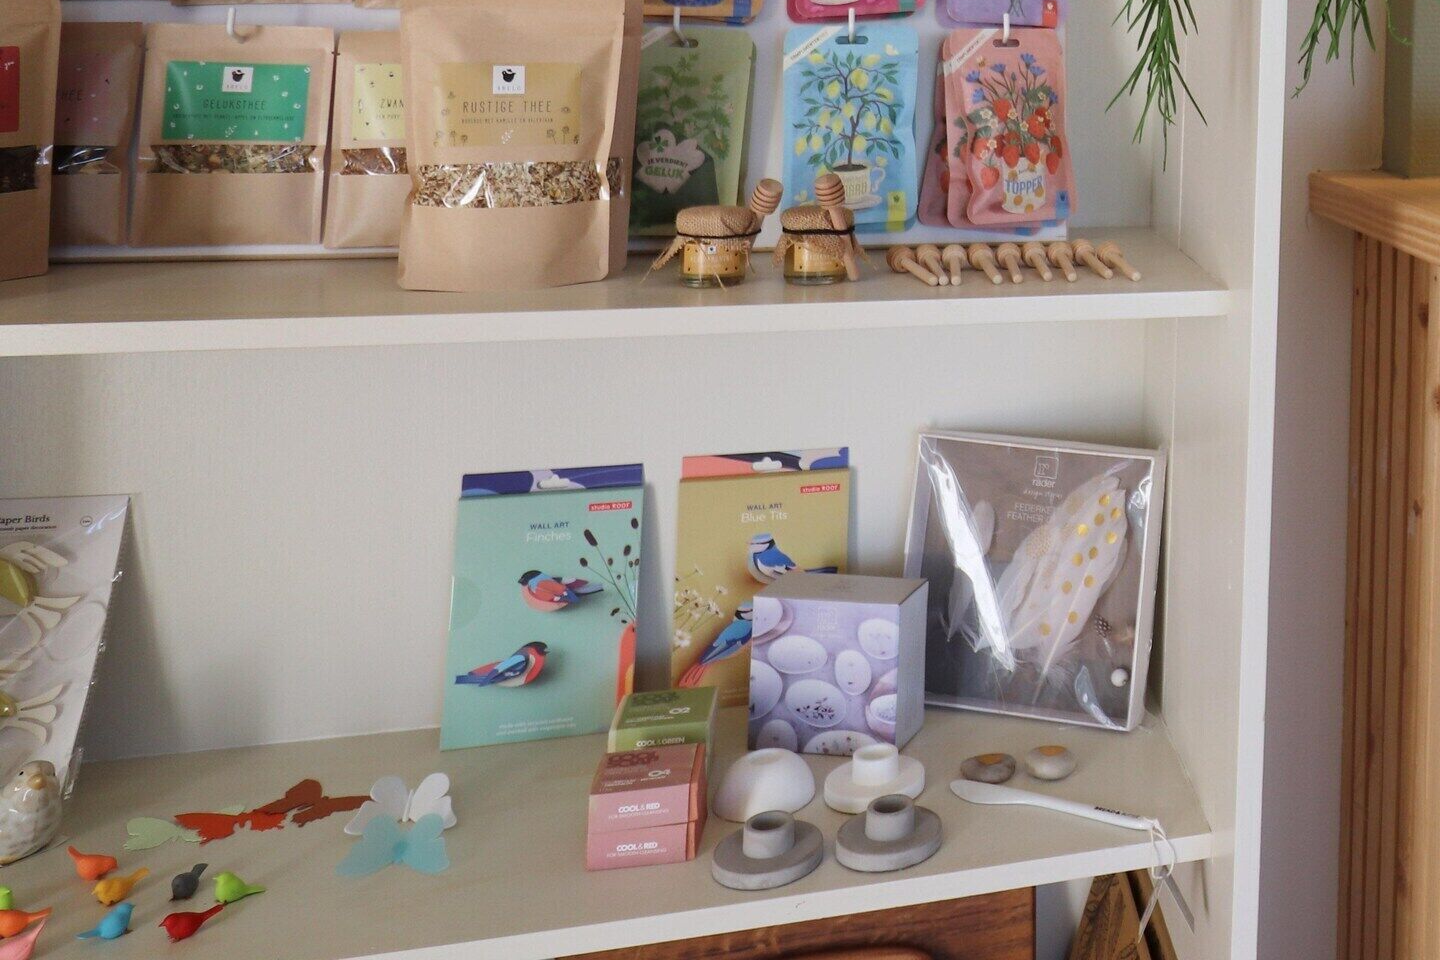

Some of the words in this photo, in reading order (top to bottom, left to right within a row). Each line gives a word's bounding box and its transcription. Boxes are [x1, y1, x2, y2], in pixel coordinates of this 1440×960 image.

[203, 99, 266, 112] GELUKSTHEE
[380, 97, 405, 109] ZWAN
[462, 100, 514, 114] RUSTIGE
[522, 100, 552, 114] THEE
[1005, 175, 1044, 195] TOPPER
[590, 503, 611, 512] studio
[768, 502, 783, 510] ART
[0, 515, 23, 526] aper
[25, 514, 51, 524] Birds
[740, 511, 766, 523] Blue
[770, 510, 789, 521] Tits
[530, 522, 552, 530] WALL
[553, 521, 570, 529] ART
[525, 530, 572, 542] Finches
